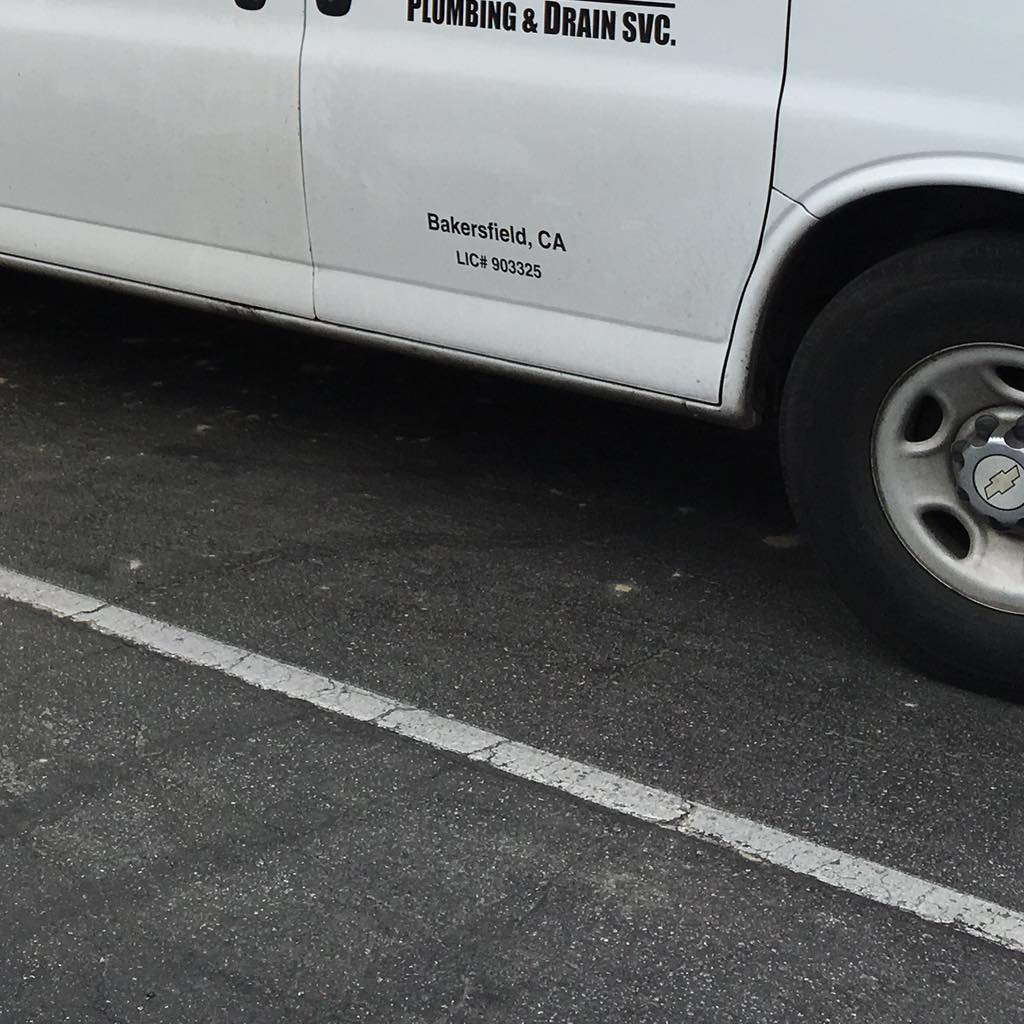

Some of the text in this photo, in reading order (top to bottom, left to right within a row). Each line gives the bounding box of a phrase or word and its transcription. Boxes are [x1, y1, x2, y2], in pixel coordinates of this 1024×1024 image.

[521, 8, 539, 33] &
[543, 0, 617, 41] DRAIN
[621, 11, 677, 47] SVC.
[426, 212, 567, 253] Bakersfield, CA
[456, 250, 543, 279] LIC# 903325
